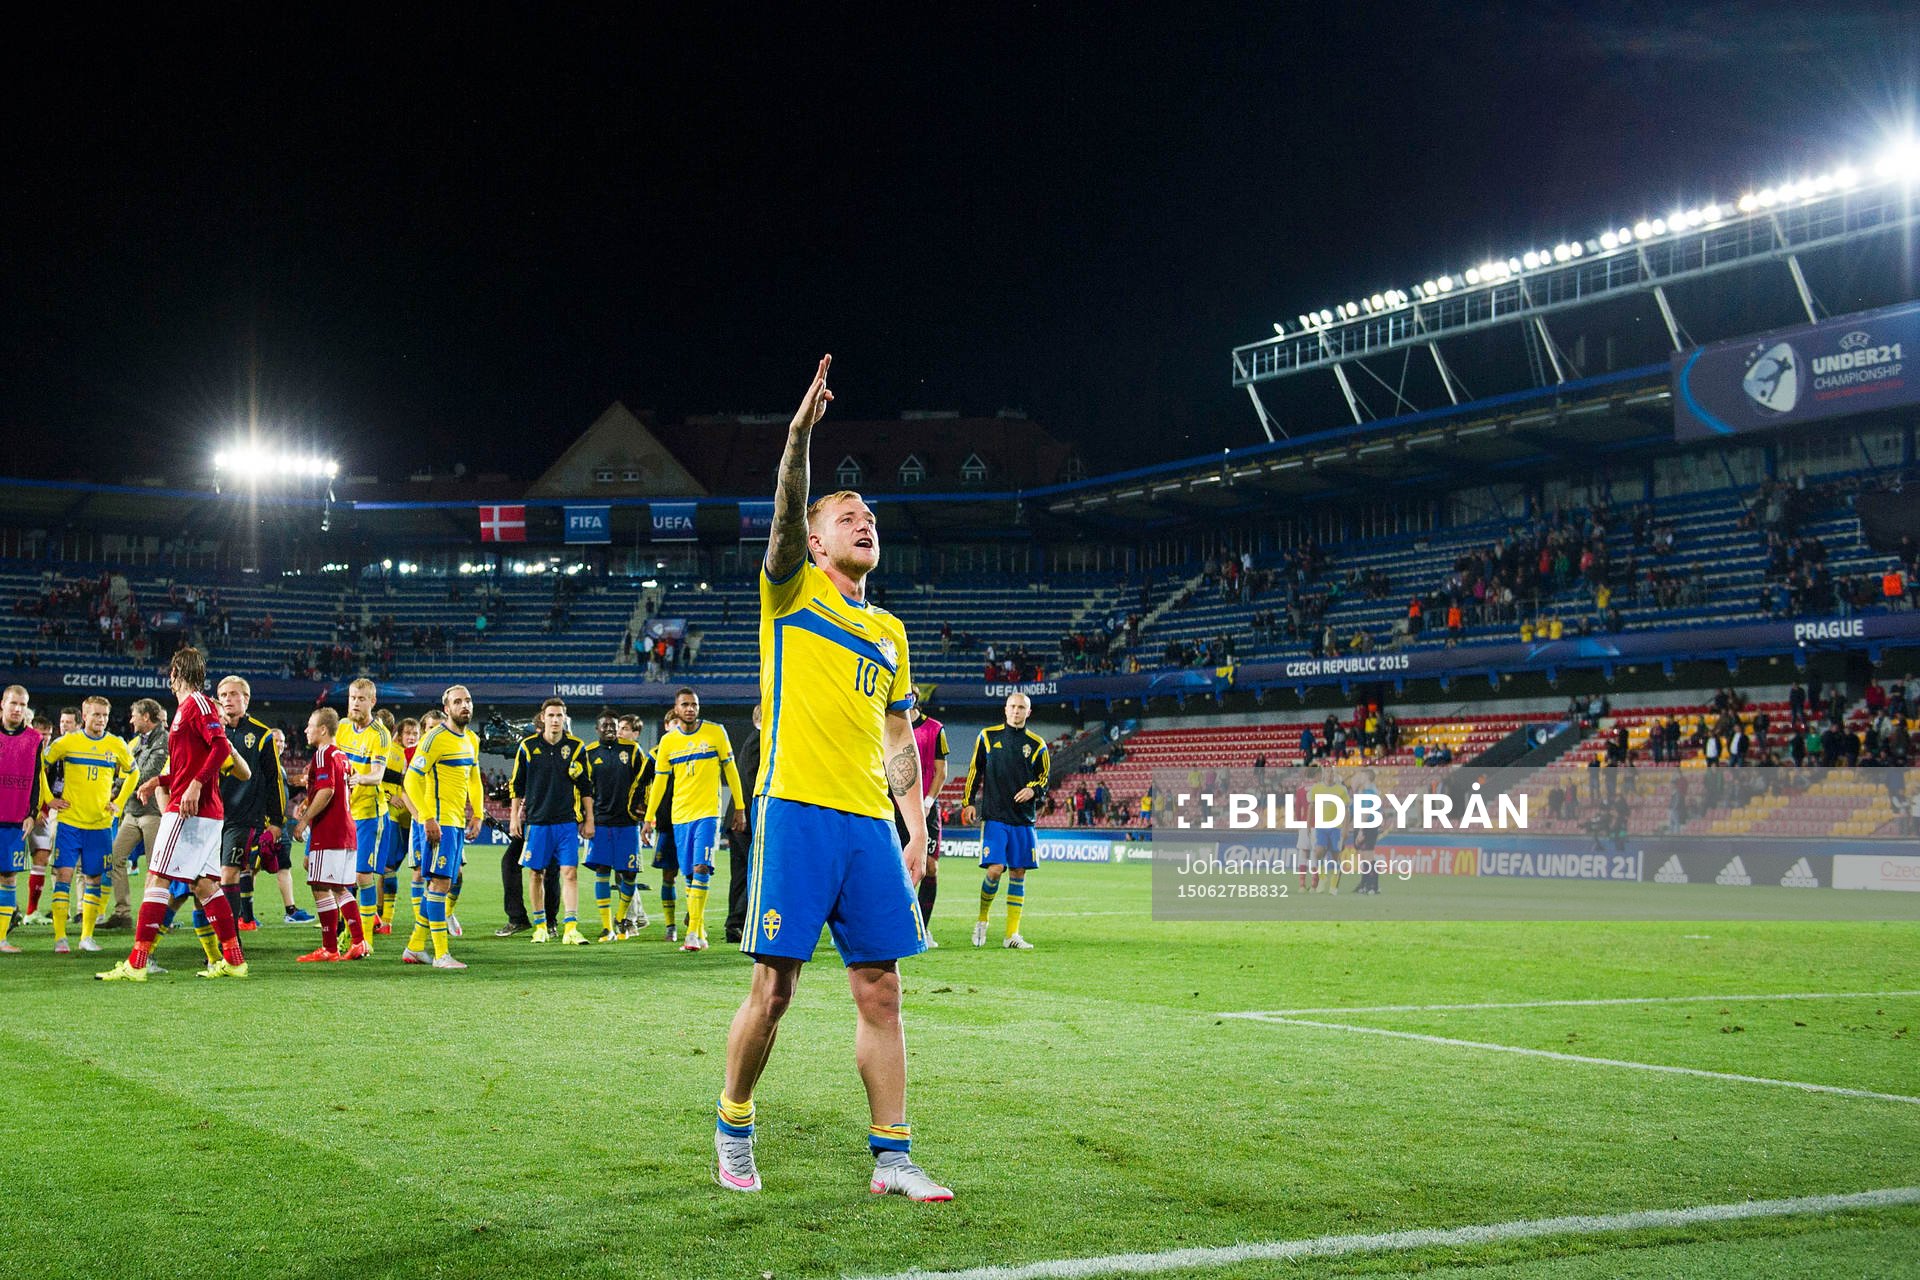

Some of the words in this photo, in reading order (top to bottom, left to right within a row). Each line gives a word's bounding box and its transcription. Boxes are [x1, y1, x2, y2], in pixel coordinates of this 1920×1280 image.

[1812, 343, 1902, 375] UNDER21
[1814, 363, 1902, 390] CHAMPIONSHIP
[570, 516, 602, 528] FIFA
[653, 517, 693, 530] UEFA
[1794, 619, 1864, 640] PRAGUE
[1286, 660, 1321, 677] CZECH
[1323, 657, 1376, 675] REPUBLIC
[1379, 655, 1409, 670] 2015
[63, 674, 106, 686] CZECH
[855, 657, 880, 697] 10
[553, 684, 603, 697] PRAGUE
[87, 766, 98, 781] 19
[13, 851, 24, 867] 22
[230, 846, 244, 864] 12
[1051, 844, 1066, 860] TO
[1067, 844, 1108, 861] RACISM
[1481, 851, 1534, 876] UEFA
[1537, 853, 1608, 879] UNDER
[1610, 855, 1636, 880] 21
